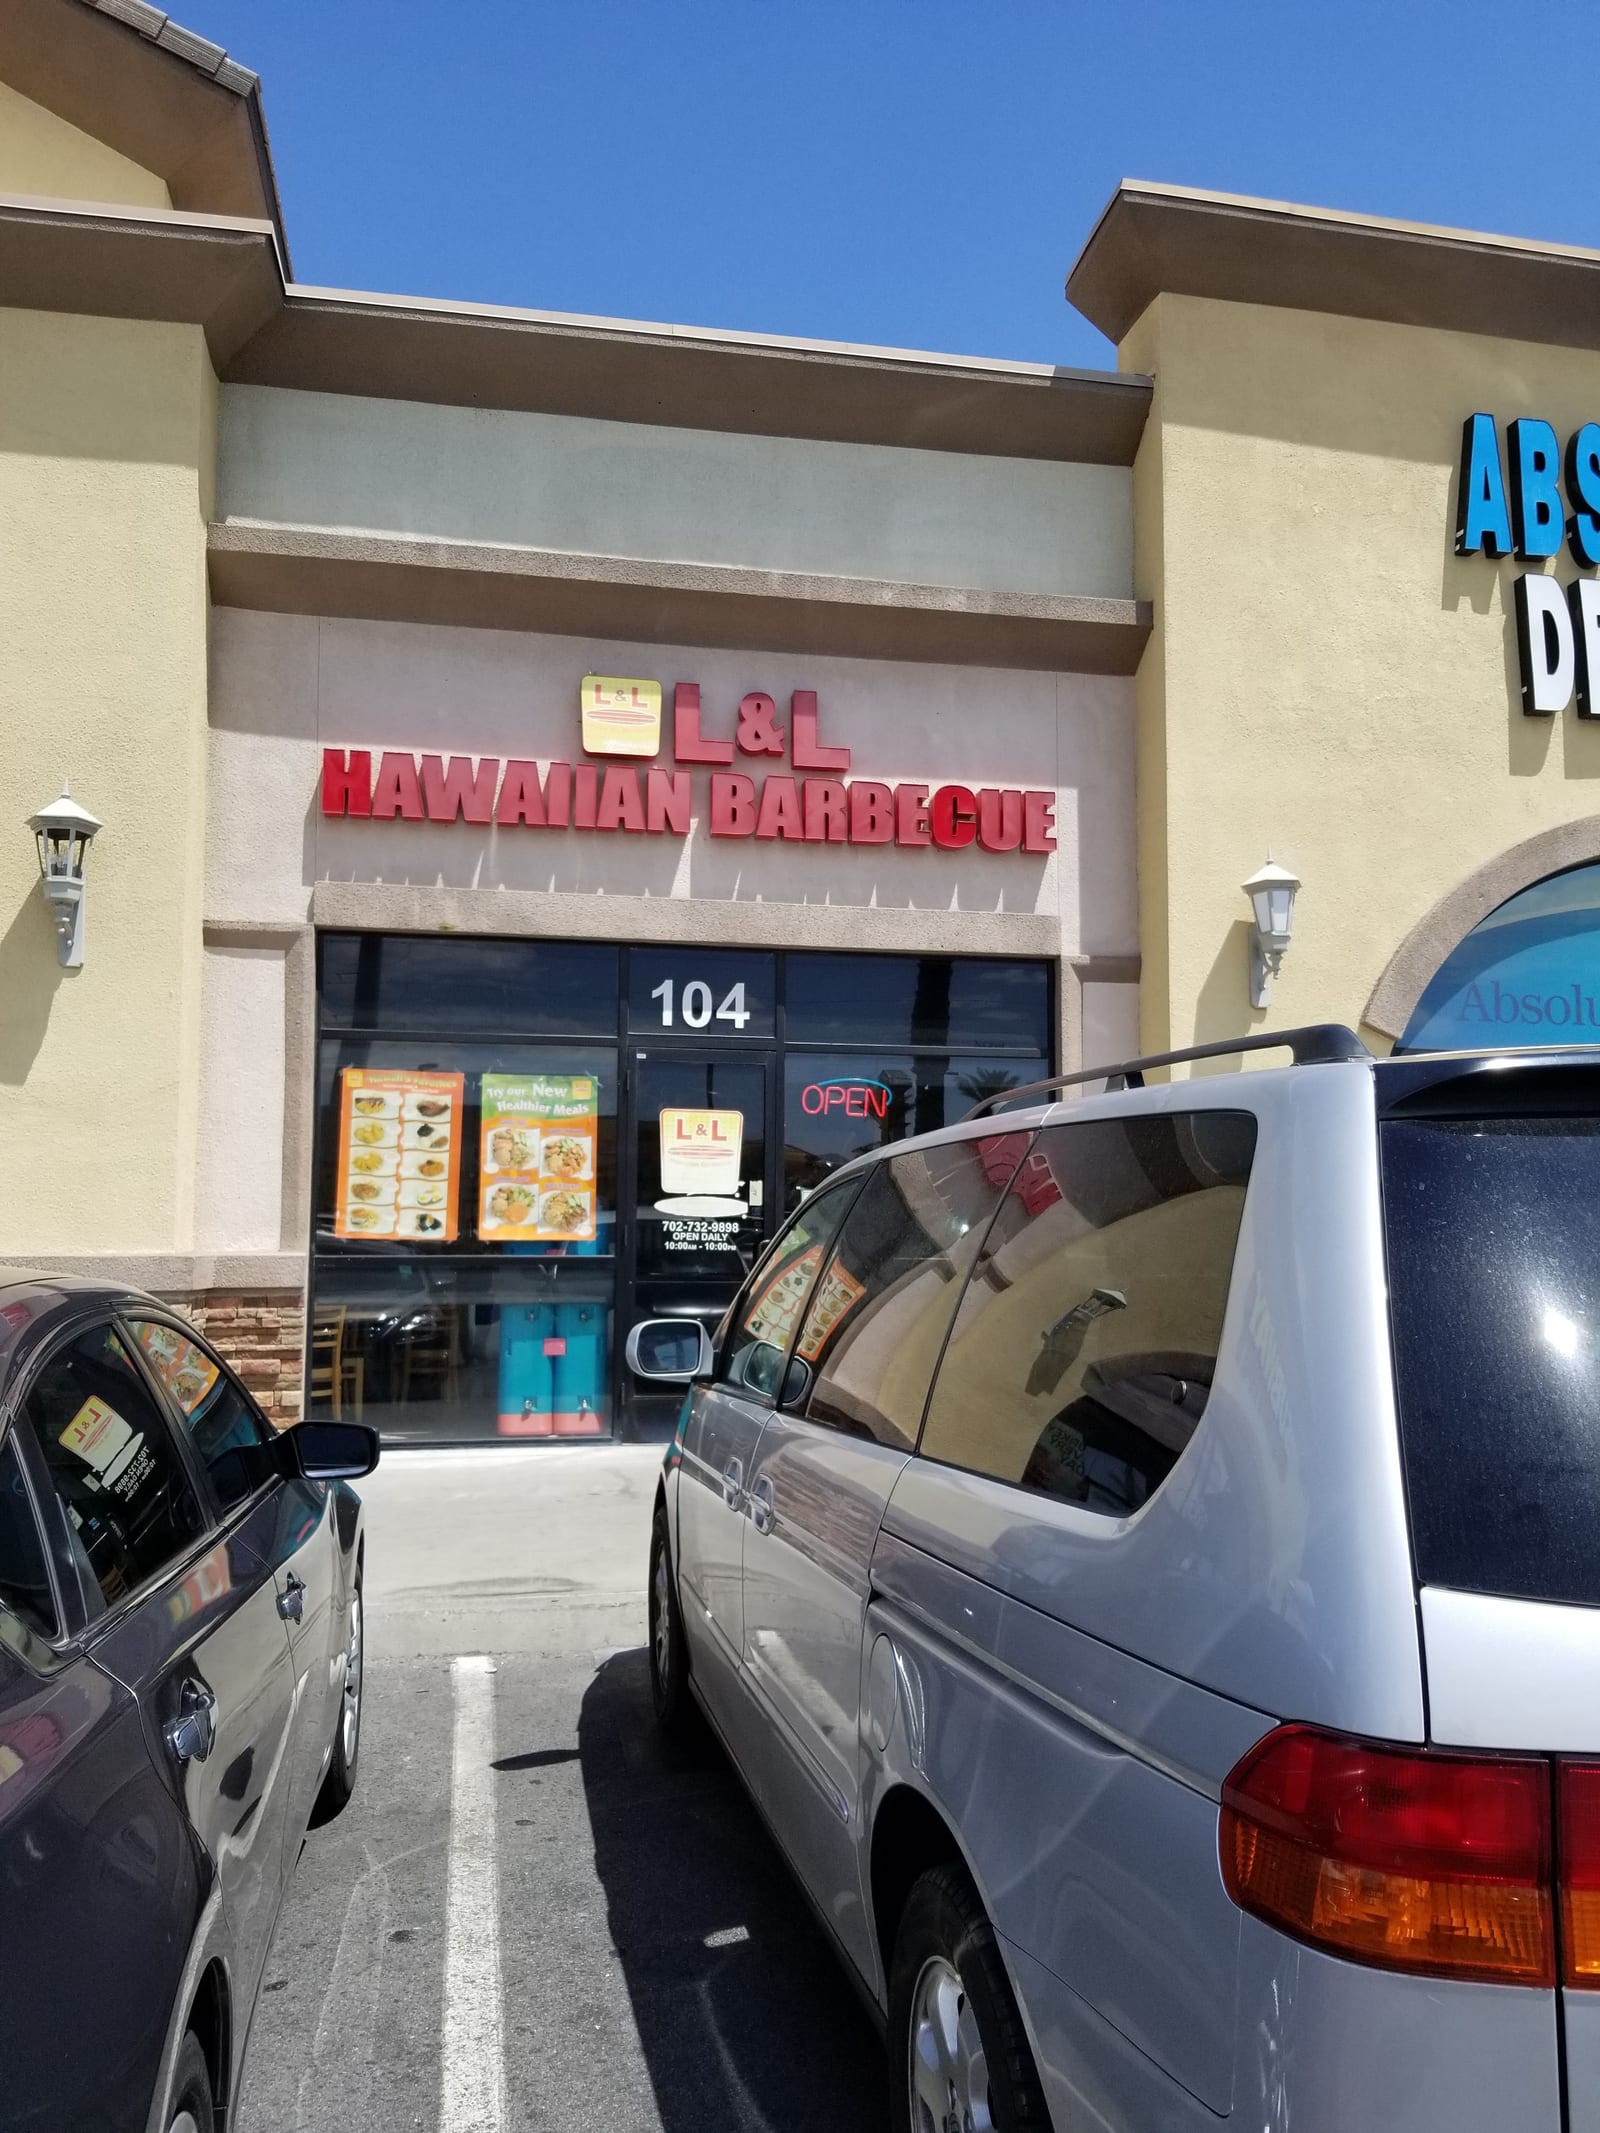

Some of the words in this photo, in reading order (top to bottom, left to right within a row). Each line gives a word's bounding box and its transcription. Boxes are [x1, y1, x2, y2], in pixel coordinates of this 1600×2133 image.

[322, 748, 691, 835] HAWAIIAN
[710, 772, 1058, 854] BARBECUE
[651, 979, 751, 1029] 104
[487, 1087, 504, 1099] Try
[507, 1087, 525, 1096] our
[532, 1082, 568, 1097] New
[497, 1100, 552, 1113] Healthier
[553, 1104, 590, 1116] Meals
[802, 1084, 888, 1118] OPEN
[662, 1220, 740, 1233] 702-732-9898
[672, 1232, 700, 1241] OPEN
[701, 1232, 729, 1242] DAILY
